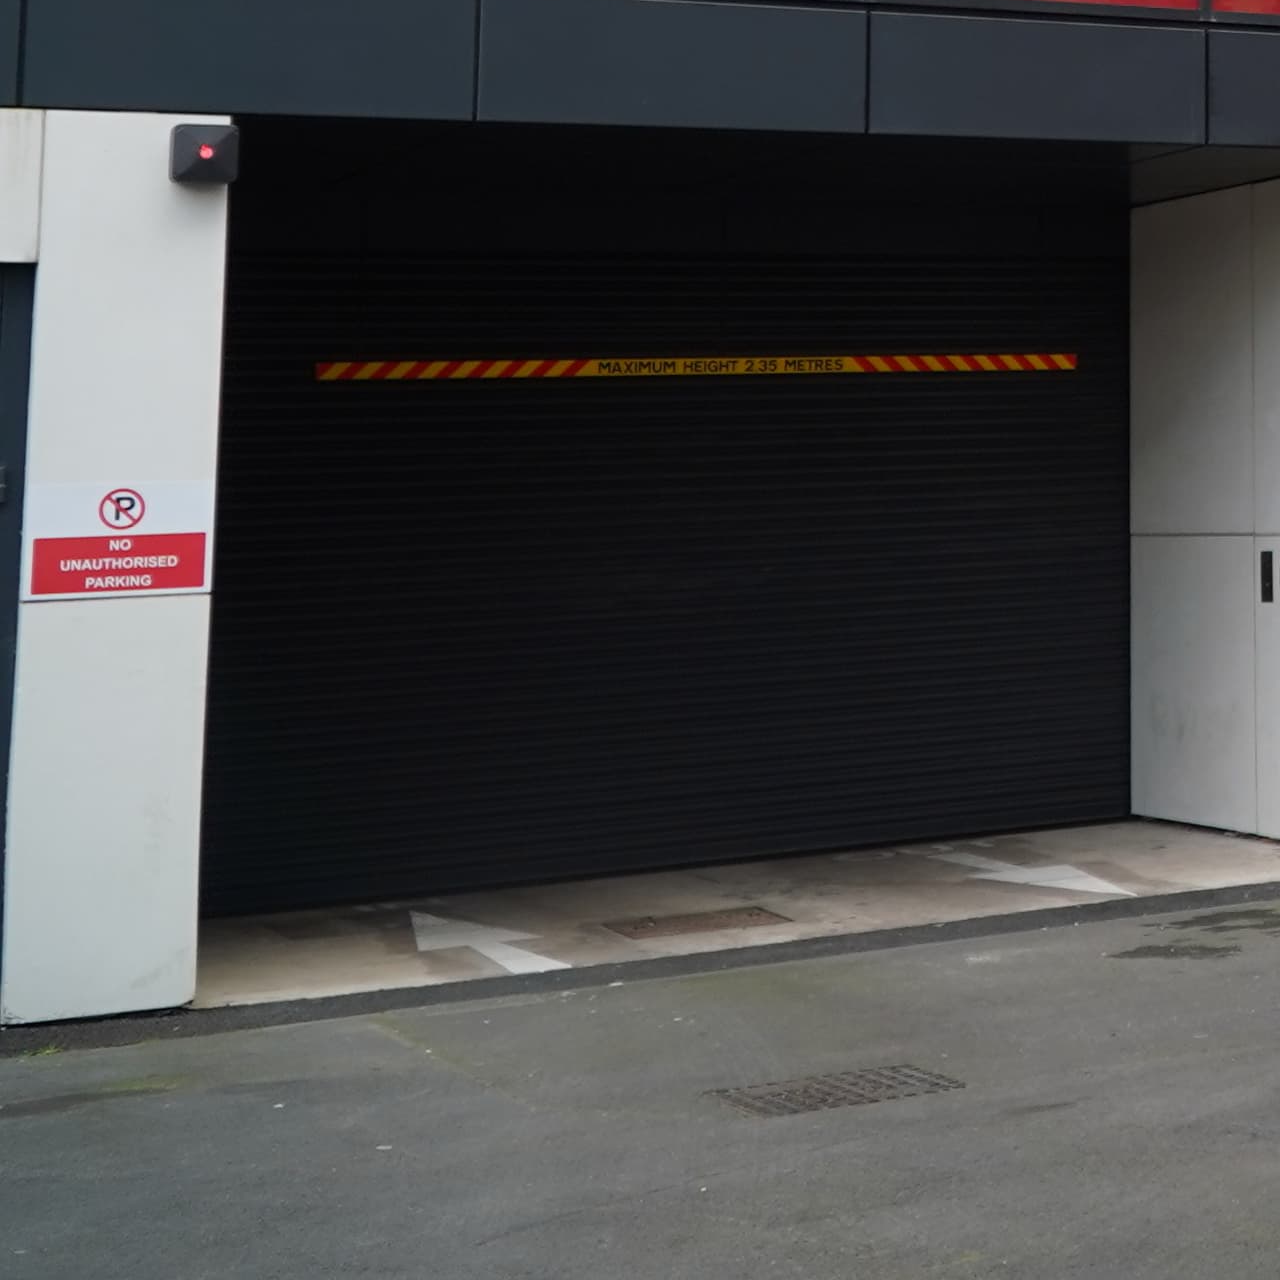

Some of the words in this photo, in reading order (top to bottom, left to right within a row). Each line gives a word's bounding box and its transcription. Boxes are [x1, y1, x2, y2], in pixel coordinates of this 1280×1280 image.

[598, 360, 676, 374] MAXIMUM
[684, 359, 739, 373] HEIGHT
[784, 357, 844, 372] METRES
[108, 538, 133, 552] NO
[59, 555, 179, 572] UNAUTHORISED
[84, 574, 152, 589] PARKING
